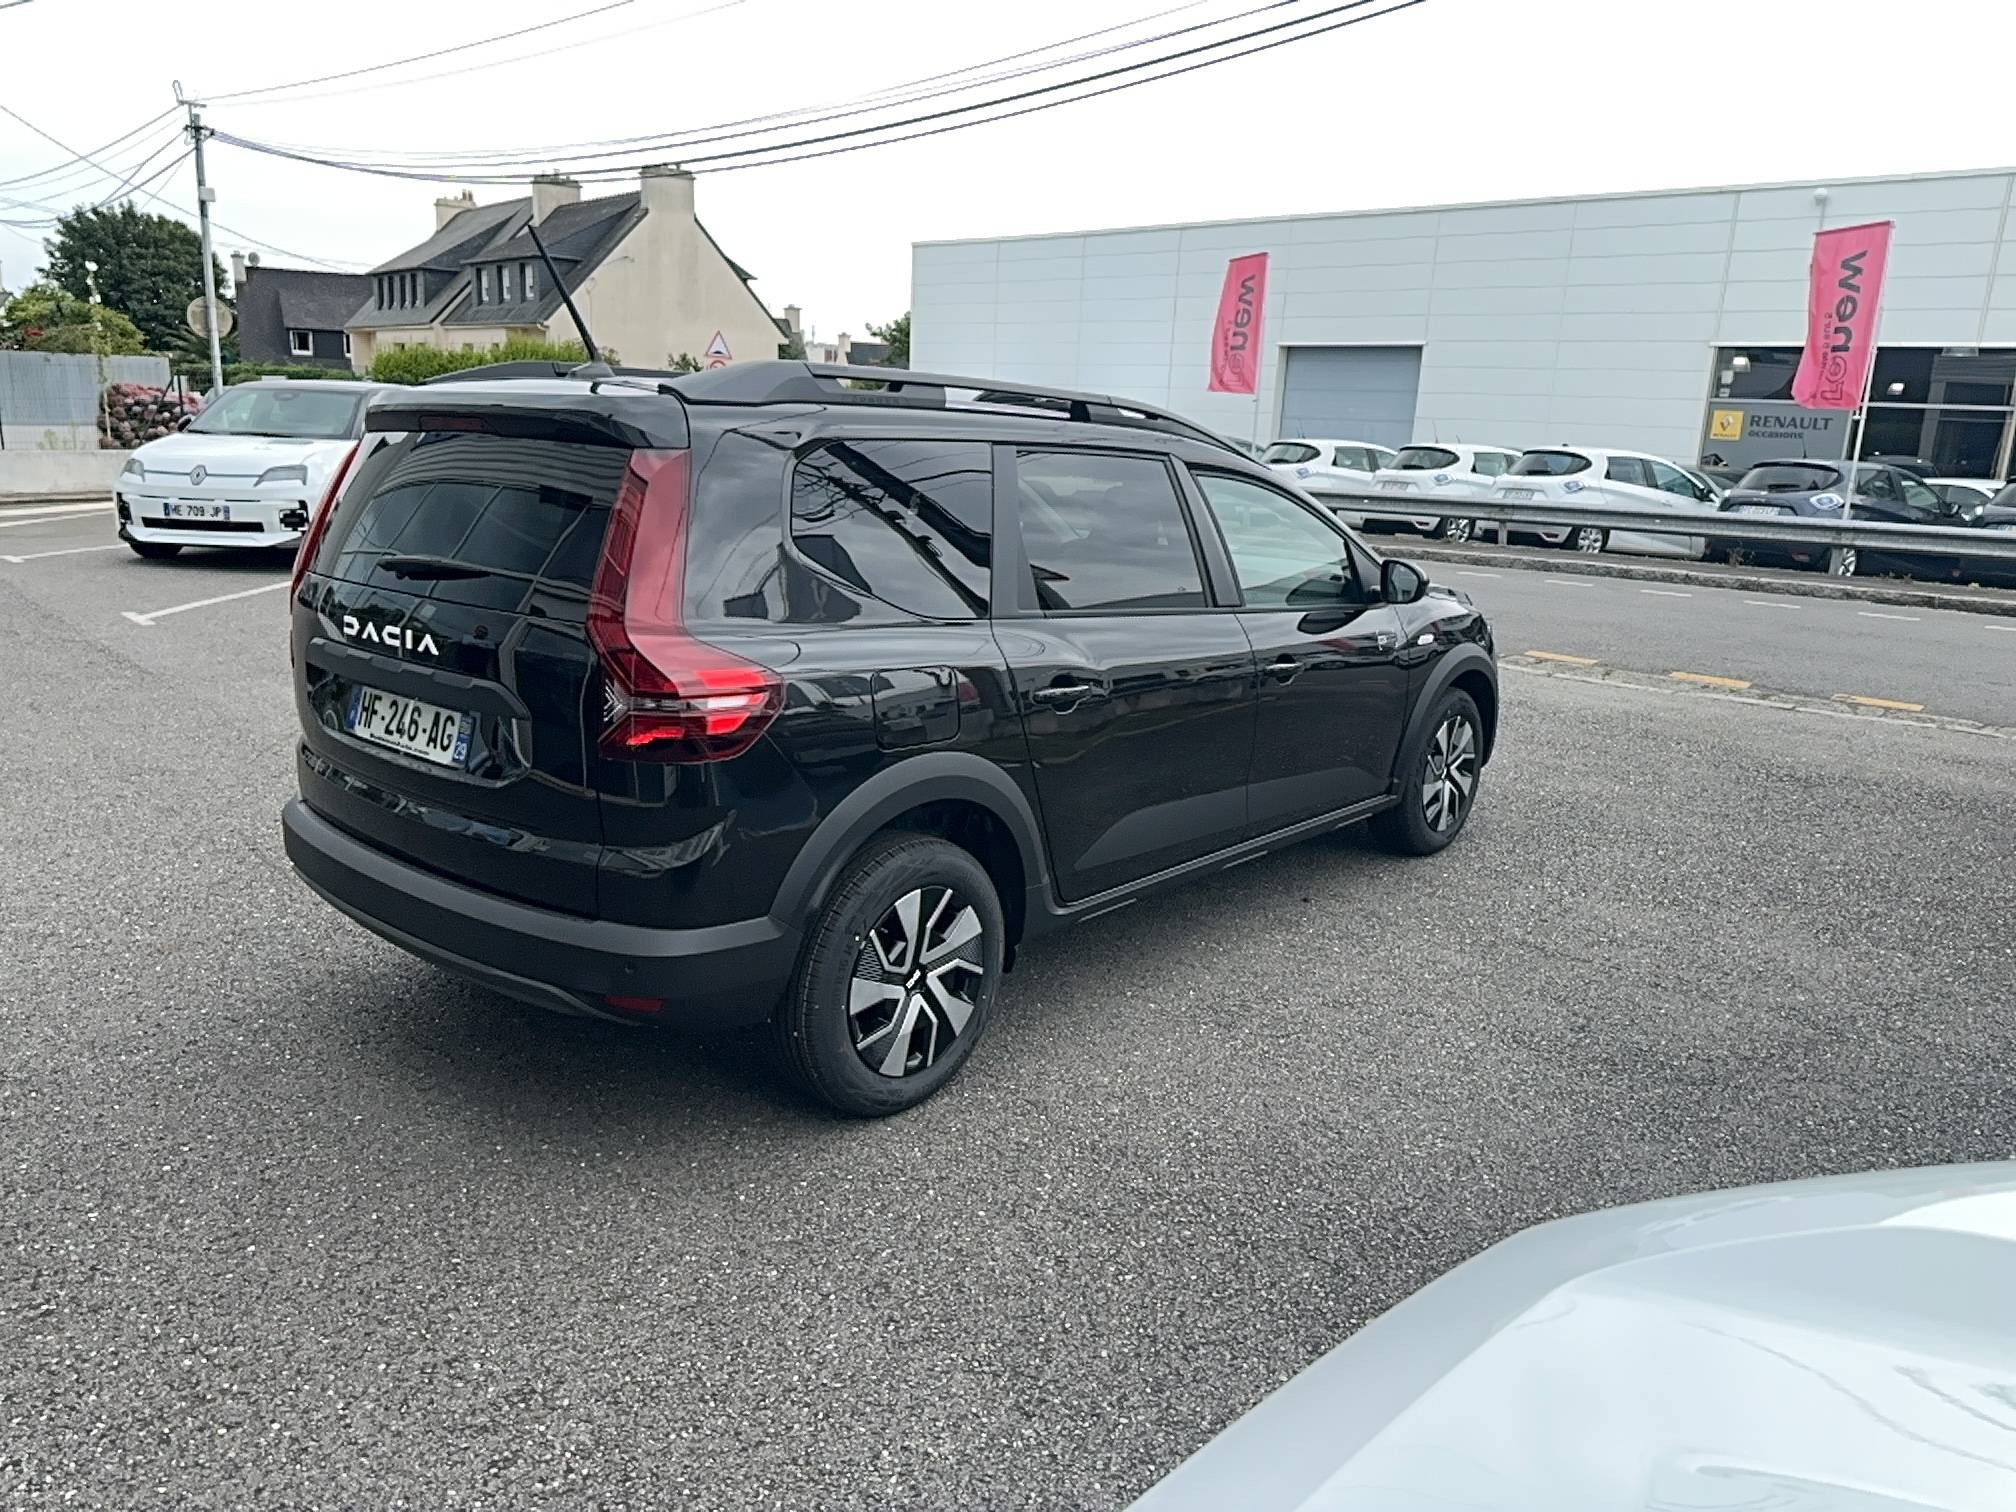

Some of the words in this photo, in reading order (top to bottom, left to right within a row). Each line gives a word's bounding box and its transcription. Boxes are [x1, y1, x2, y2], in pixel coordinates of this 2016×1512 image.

[1747, 429, 1804, 440] occasions
[1749, 414, 1833, 431] RENAULT
[343, 614, 439, 656] DACIA
[358, 690, 455, 752] HF-246-AG
